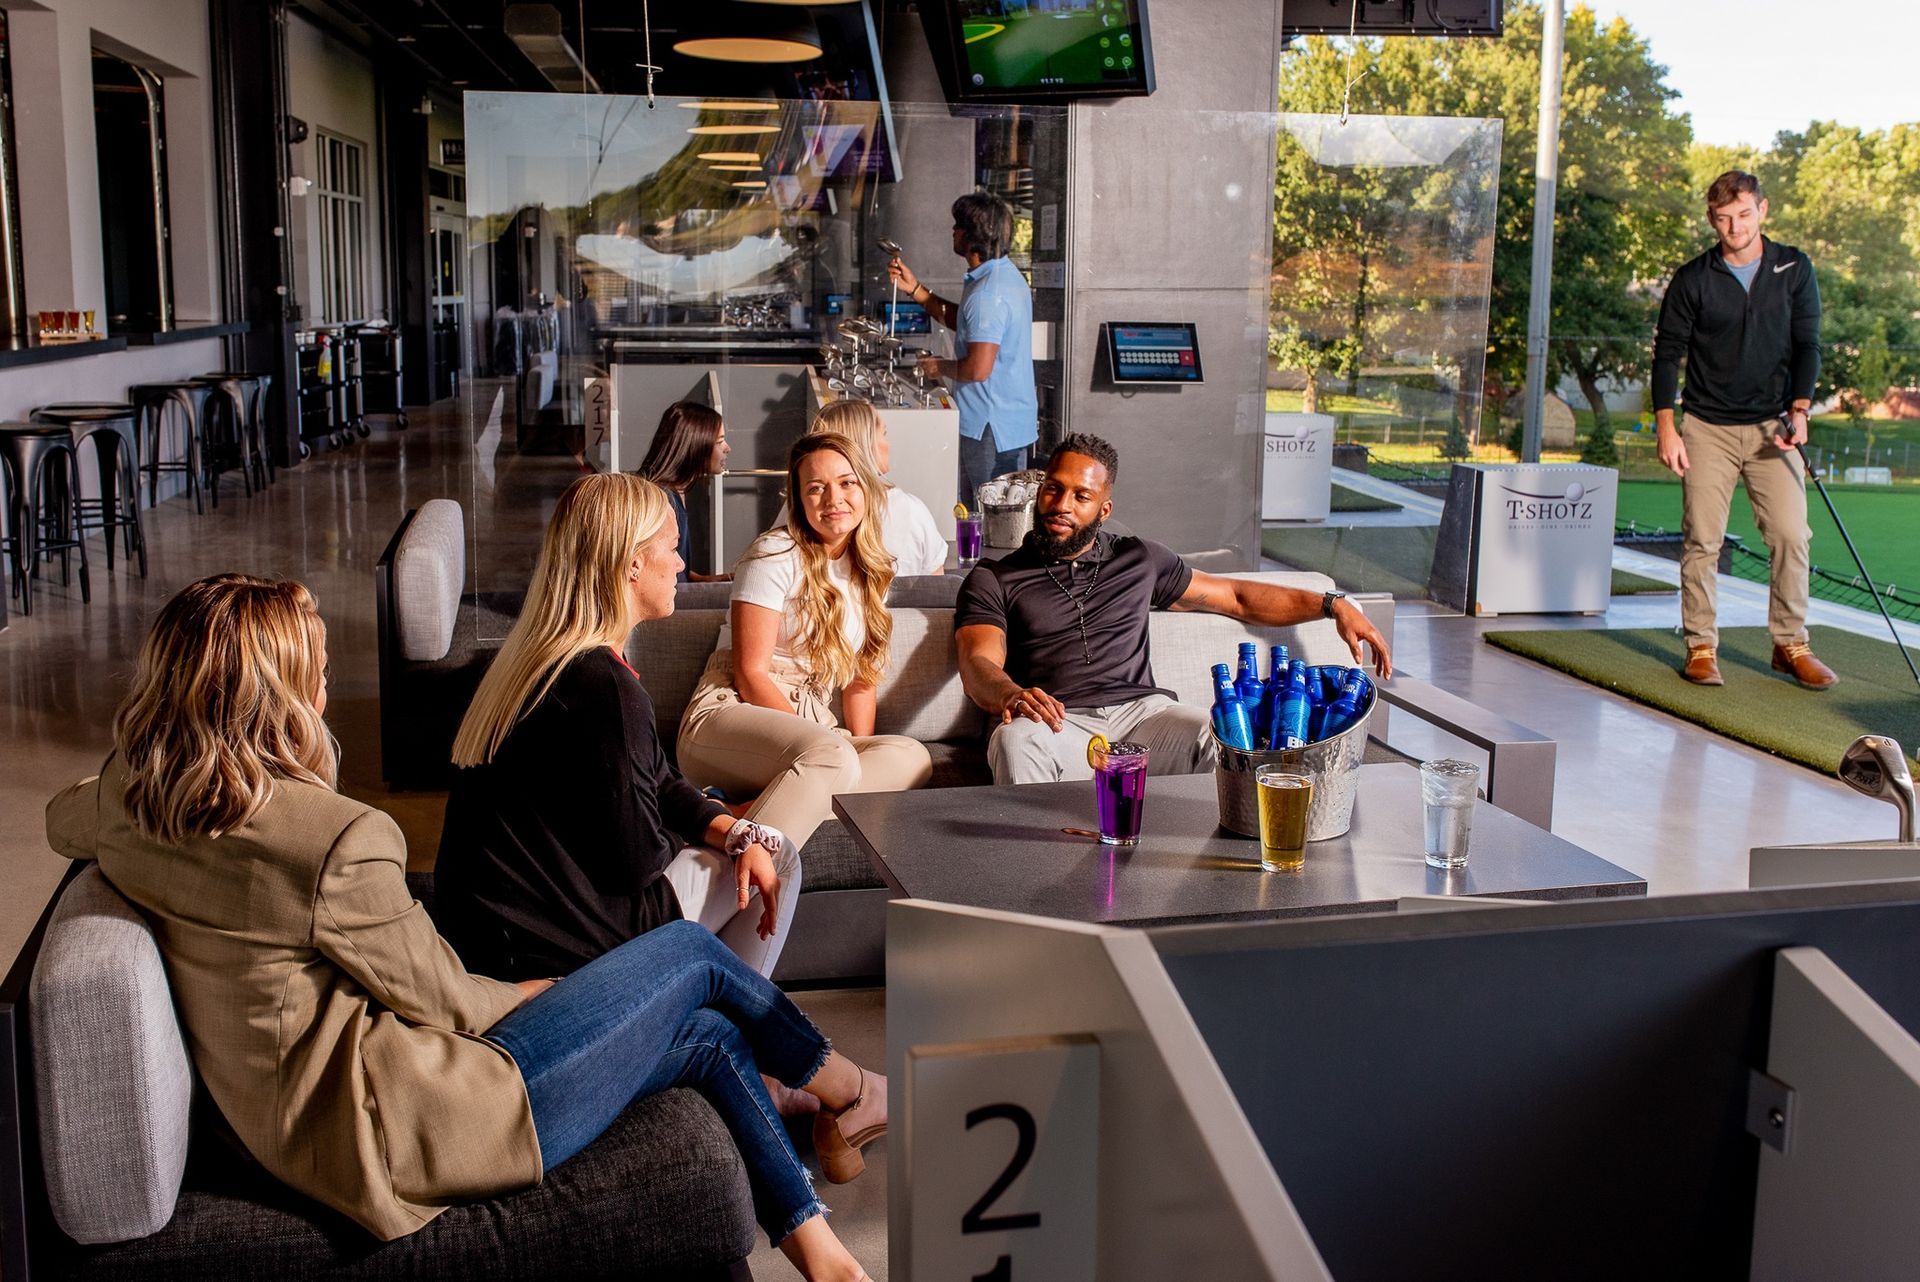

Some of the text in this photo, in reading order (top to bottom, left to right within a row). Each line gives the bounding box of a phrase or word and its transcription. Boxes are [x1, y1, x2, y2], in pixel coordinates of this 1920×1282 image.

[592, 384, 605, 446] 217
[1266, 440, 1316, 453] SHOTZ
[962, 1103, 1041, 1282] 2
